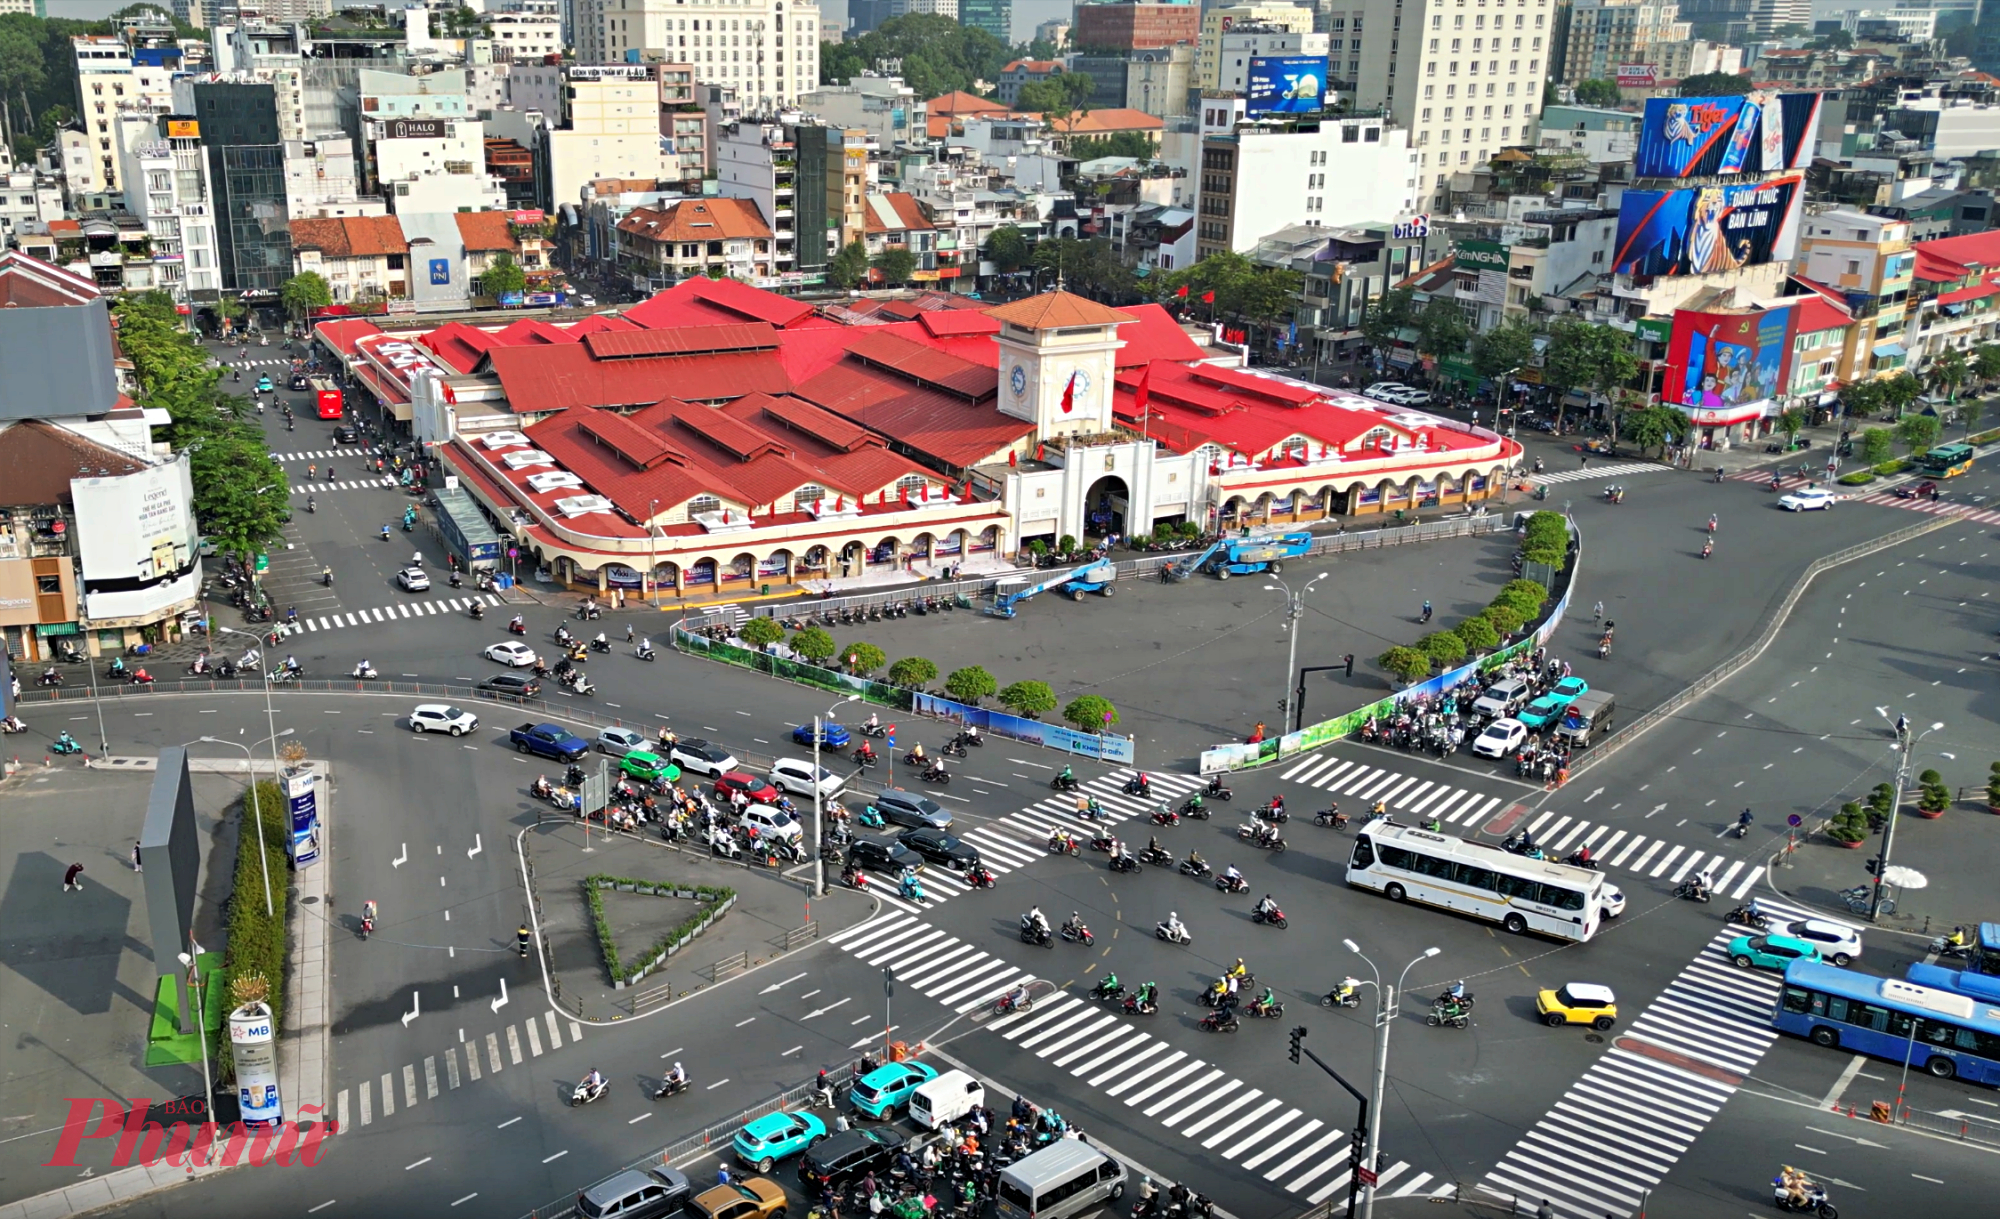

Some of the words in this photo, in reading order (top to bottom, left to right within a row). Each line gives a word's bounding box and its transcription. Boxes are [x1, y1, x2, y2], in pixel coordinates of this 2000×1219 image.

[1690, 102, 1728, 132] Tiger
[409, 124, 435, 132] HALO
[1758, 186, 1779, 205] THỨC
[1728, 209, 1746, 229] BẢN
[1748, 208, 1768, 228] LĨNH
[434, 272, 446, 280] PNJ
[144, 488, 168, 501] Legend
[611, 568, 628, 578] Vikki
[248, 1026, 269, 1036] MB
